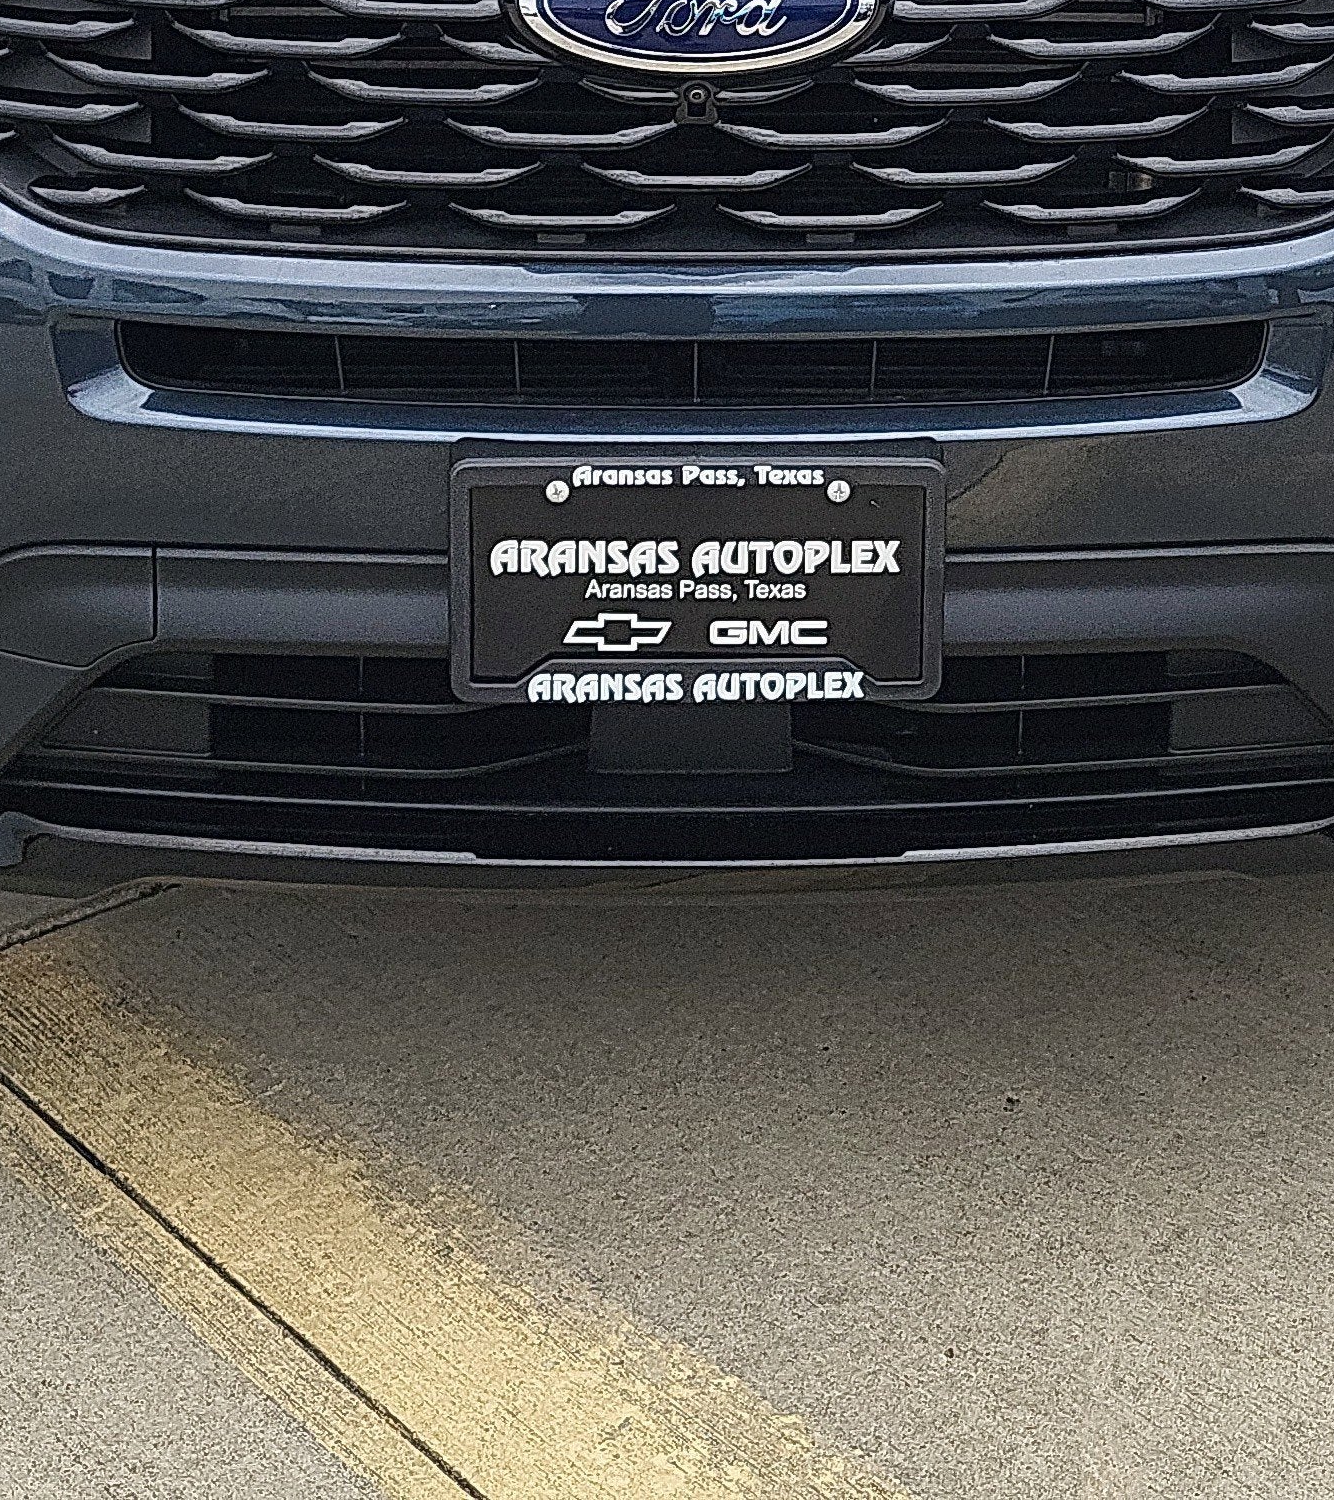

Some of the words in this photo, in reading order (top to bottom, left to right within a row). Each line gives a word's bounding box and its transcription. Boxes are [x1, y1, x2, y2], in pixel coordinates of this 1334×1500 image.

[572, 466, 673, 487] Aransas
[681, 466, 746, 488] Pass,
[753, 465, 825, 485] Texas
[491, 539, 679, 577] ARANSAS
[691, 539, 901, 577] AUTOPLEX
[585, 579, 673, 600] Aransas
[678, 579, 738, 602] Pass,
[744, 579, 807, 600] Texas
[709, 619, 829, 646] GMC
[527, 672, 684, 704] ARANSAS
[692, 670, 866, 704] AUTOPLEX
